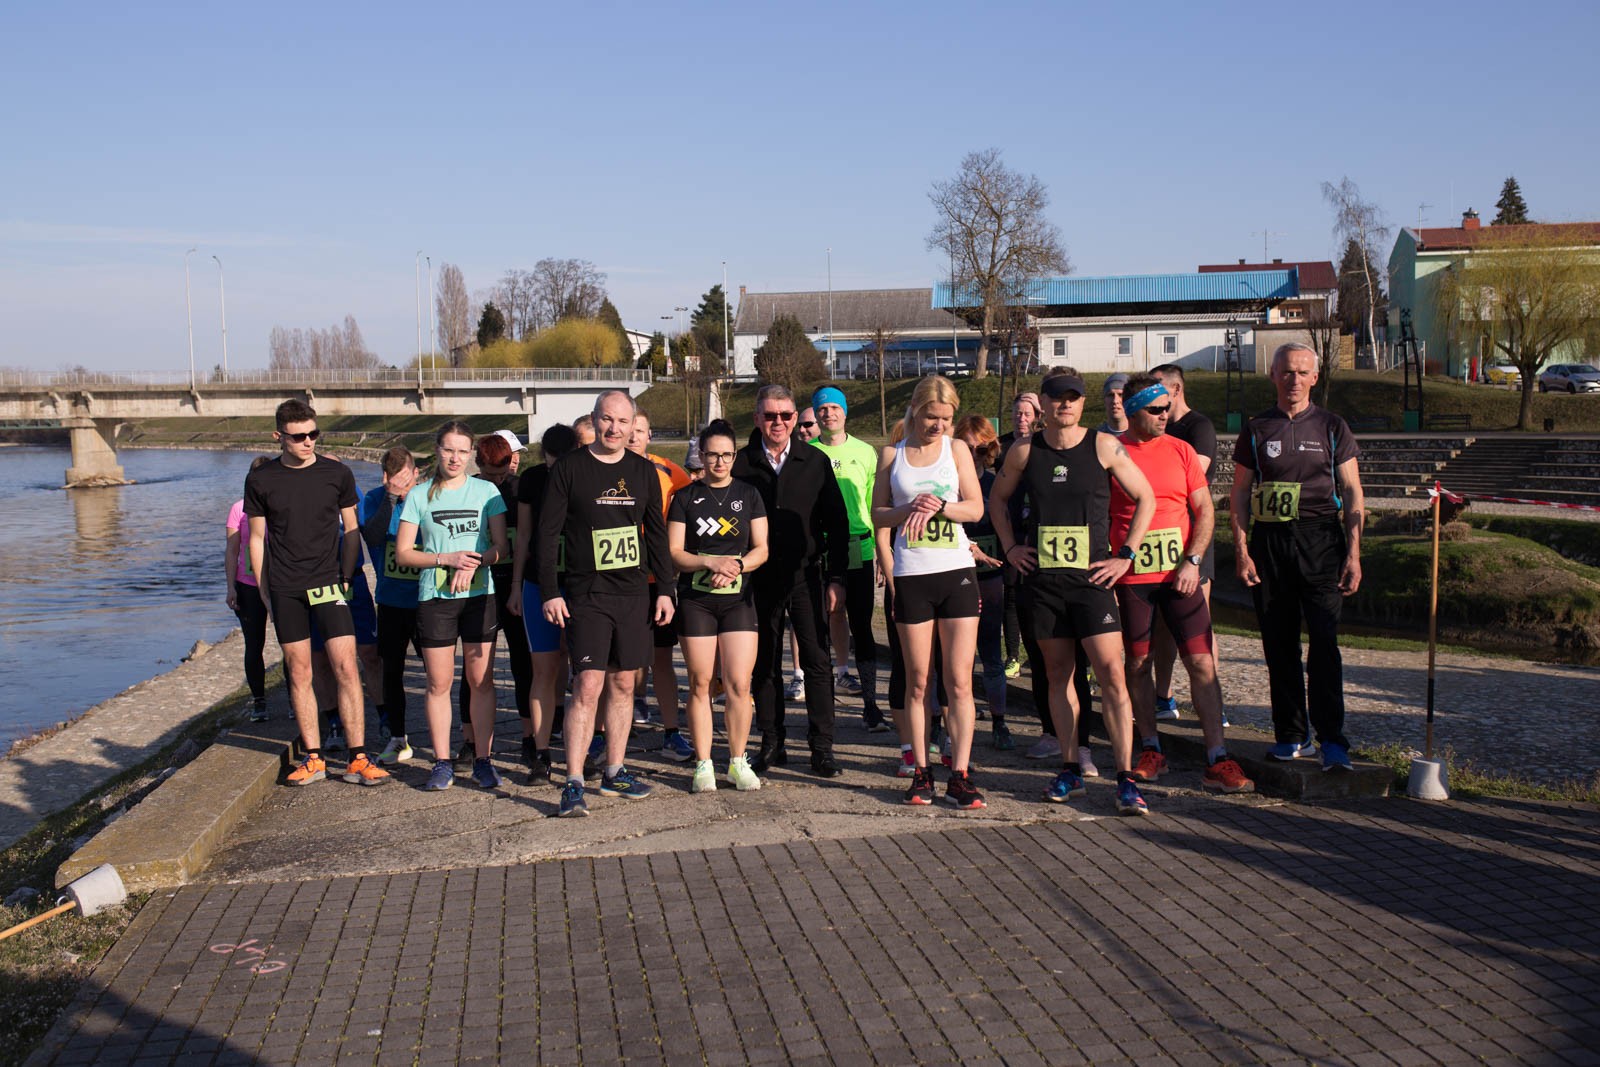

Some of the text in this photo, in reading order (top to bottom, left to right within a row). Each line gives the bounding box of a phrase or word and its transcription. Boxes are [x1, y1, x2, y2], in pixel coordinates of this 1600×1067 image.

[1255, 491, 1293, 517] 148
[917, 516, 955, 543] 94
[599, 536, 637, 565] 245
[1047, 536, 1078, 563] 13
[1139, 539, 1180, 568] 316
